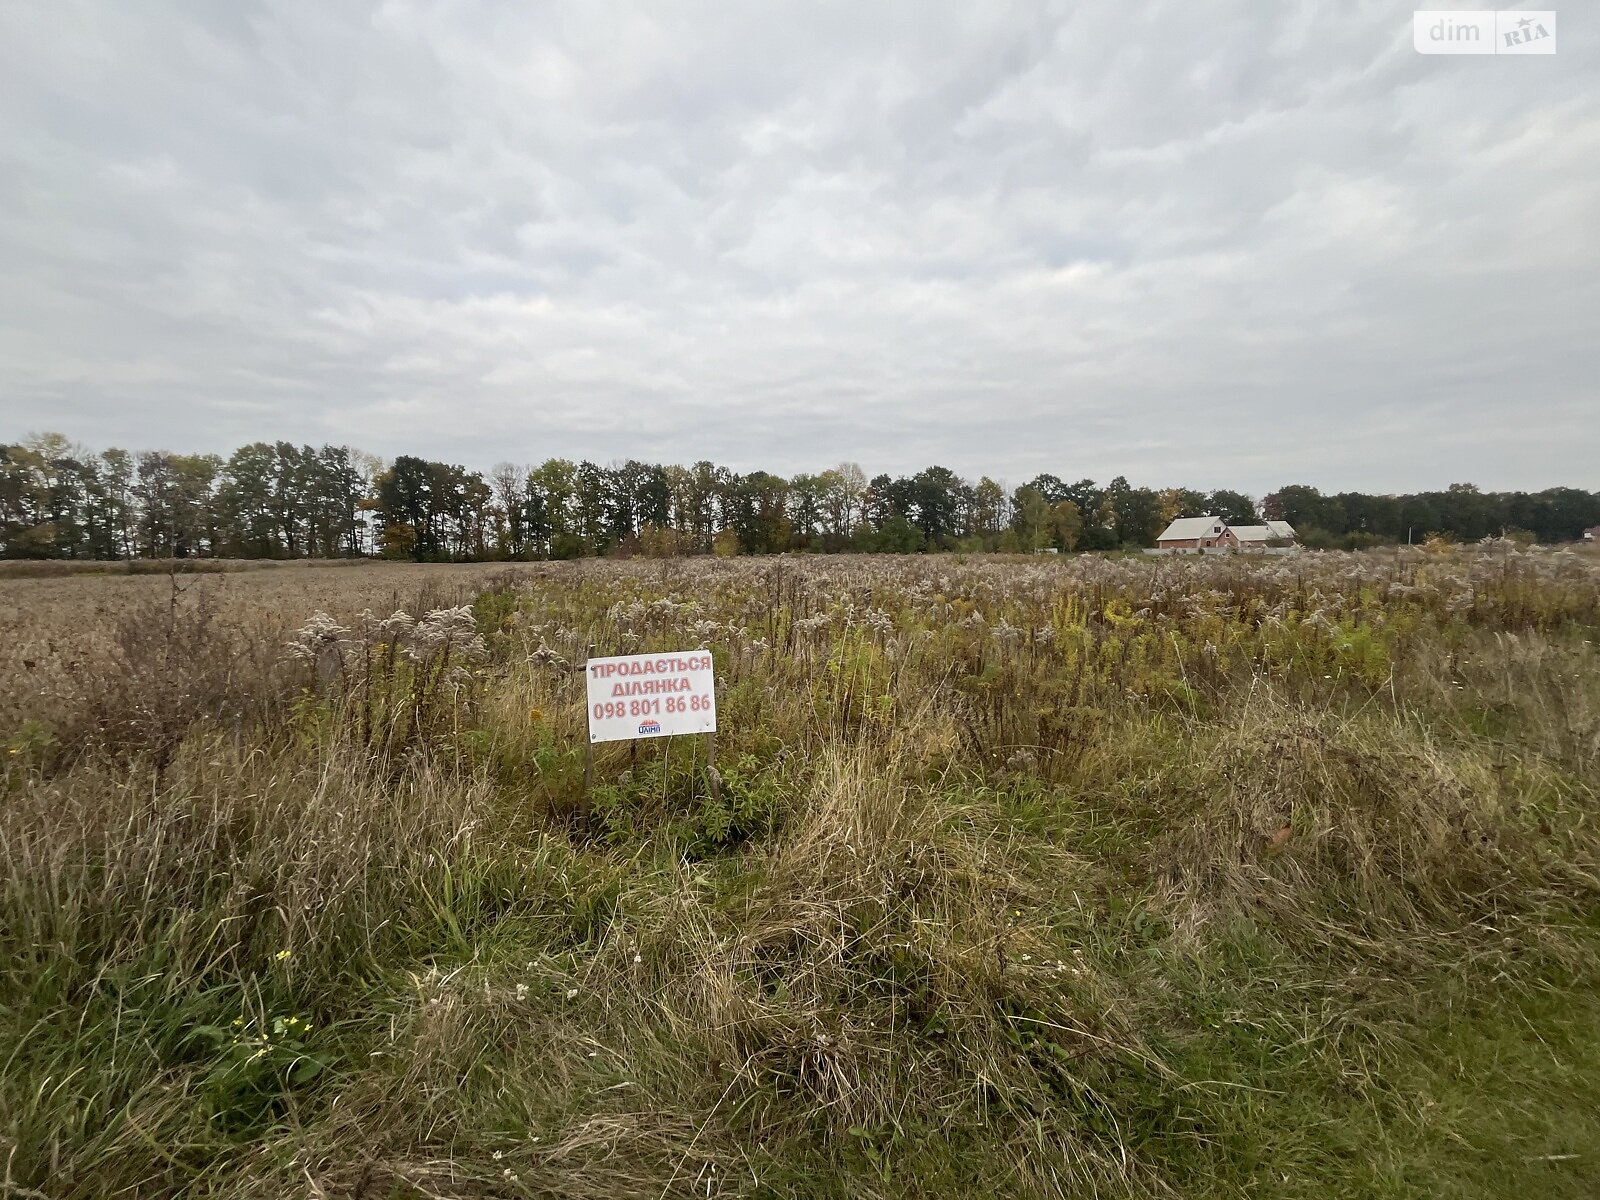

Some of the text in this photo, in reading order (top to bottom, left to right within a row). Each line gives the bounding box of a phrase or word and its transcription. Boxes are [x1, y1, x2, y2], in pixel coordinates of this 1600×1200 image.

[593, 656, 711, 678] ПРОДАЄТЬСЯ
[611, 677, 692, 697] ДІЛЯНКА
[593, 694, 711, 720] 098 801 86 86
